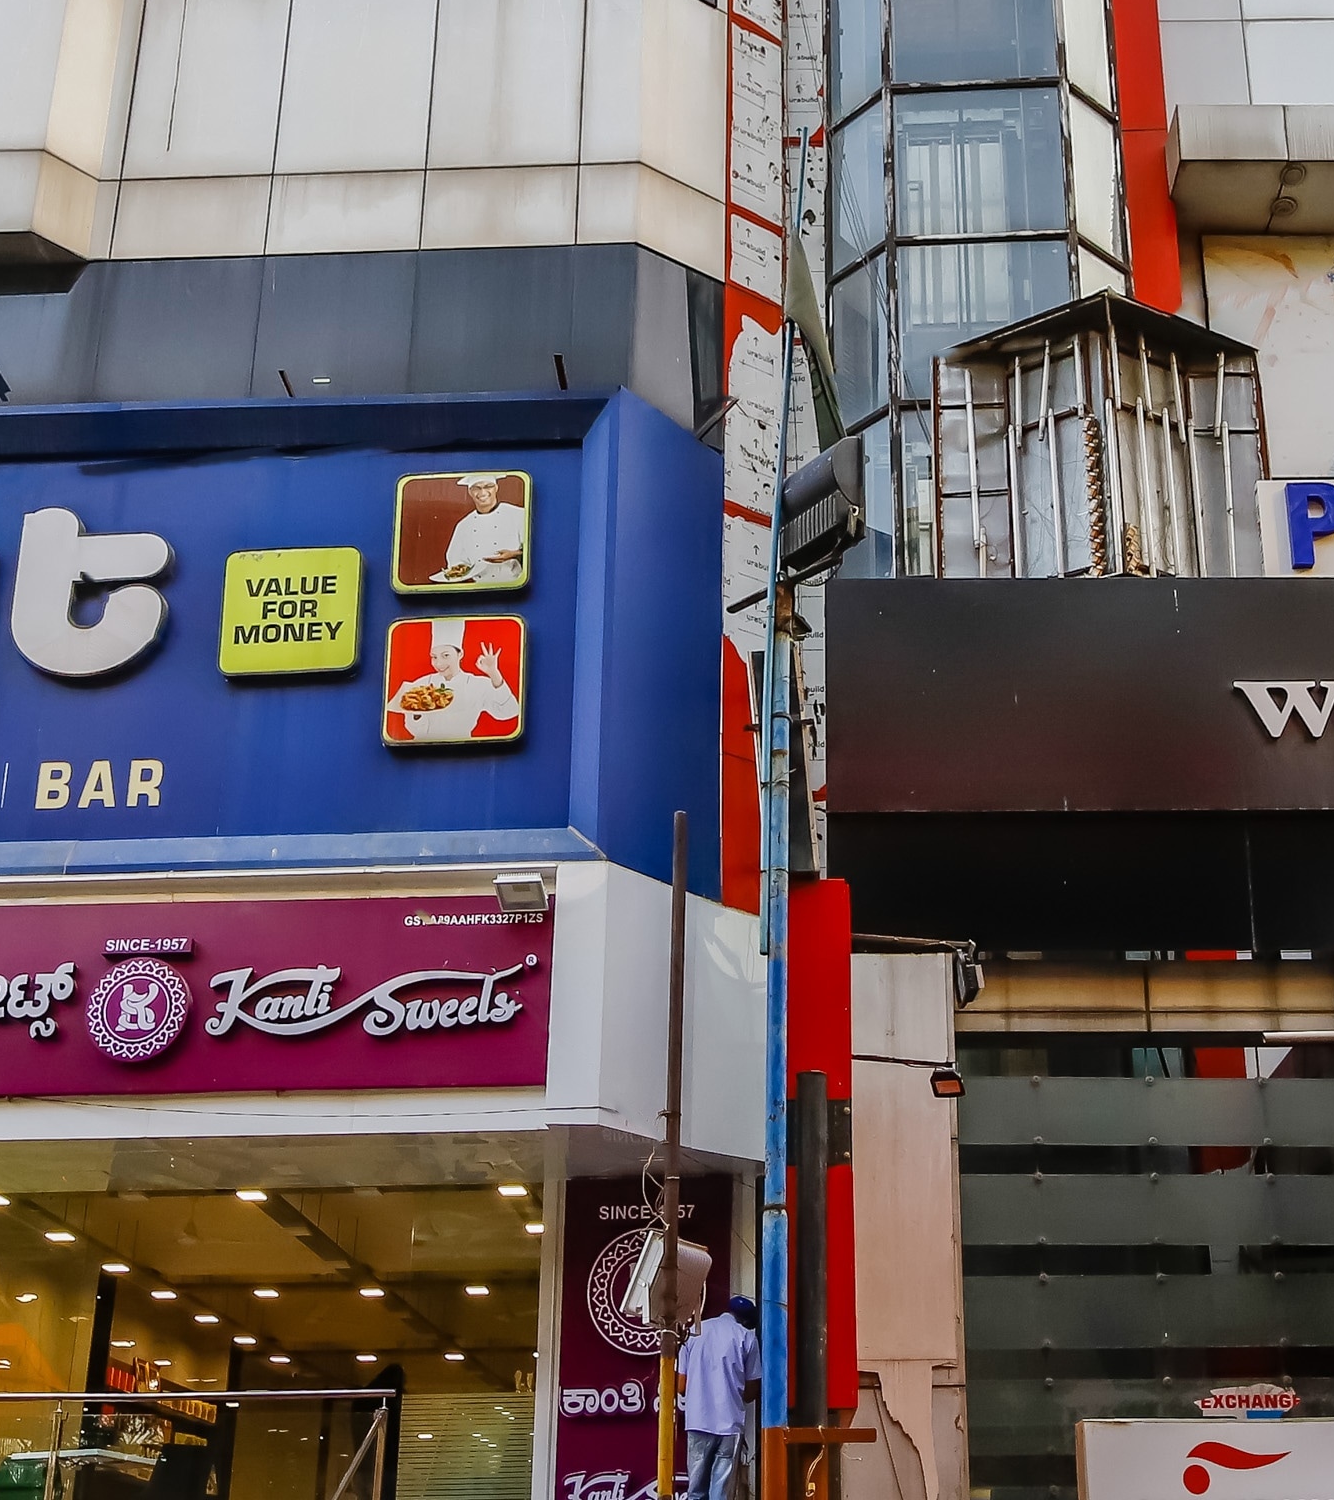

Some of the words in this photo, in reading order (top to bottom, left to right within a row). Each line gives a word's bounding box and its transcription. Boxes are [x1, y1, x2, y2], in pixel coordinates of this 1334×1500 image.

[244, 573, 338, 599] VALUE
[262, 596, 318, 621] FOR
[233, 620, 344, 646] MONEY
[33, 757, 165, 810] BAR
[105, 937, 188, 954] SINCE-1957
[204, 963, 347, 1037] Kanti
[361, 963, 524, 1037] Sweets
[599, 1204, 696, 1220] SINCE57
[562, 1380, 644, 1415] ಕಾಂತಿ
